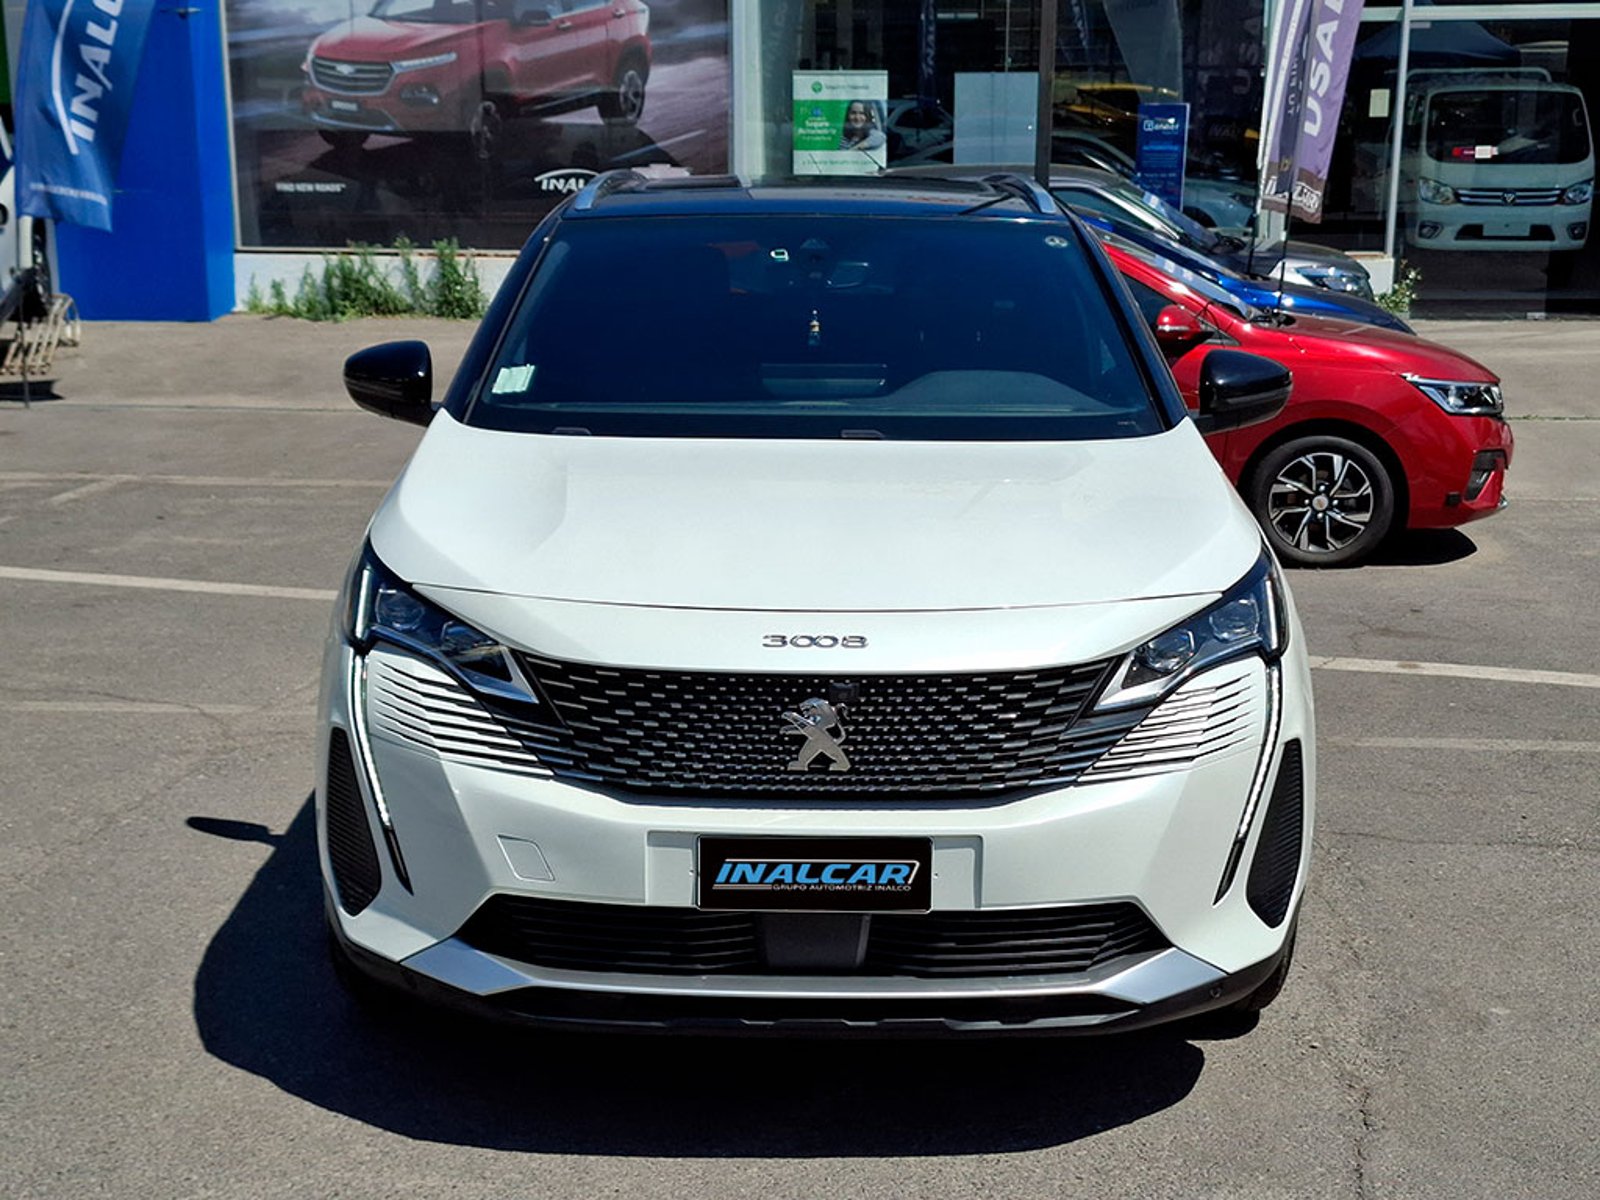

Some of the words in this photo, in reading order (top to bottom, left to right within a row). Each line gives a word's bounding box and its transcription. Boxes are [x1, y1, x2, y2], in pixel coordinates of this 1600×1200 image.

[762, 635, 869, 649] 3008
[715, 863, 911, 884] INALCAR
[772, 884, 807, 892] GRUPO
[808, 884, 872, 892] AUTOMOTRIZ
[874, 884, 912, 892] INALCO
